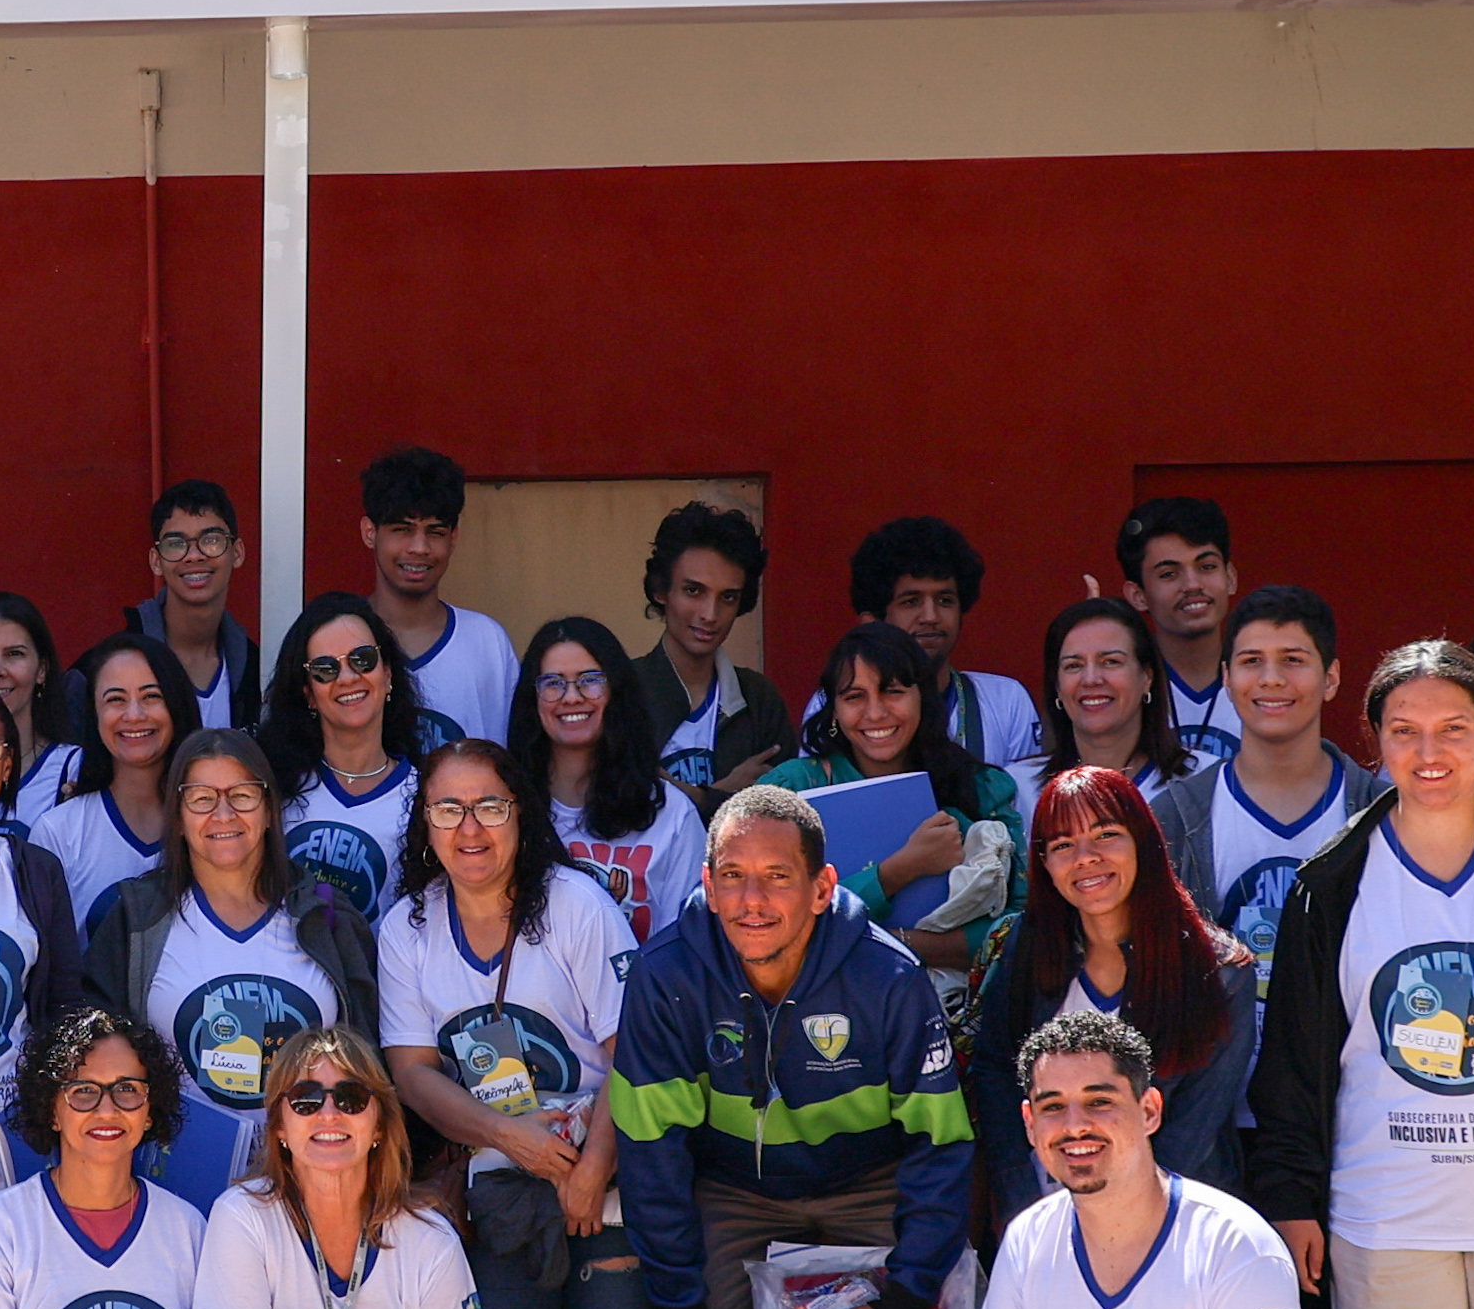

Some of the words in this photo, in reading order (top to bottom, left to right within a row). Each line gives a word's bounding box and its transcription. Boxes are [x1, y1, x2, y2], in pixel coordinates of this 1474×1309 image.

[305, 827, 367, 873] ENEM
[210, 1052, 247, 1071] Lúcia
[1388, 1111, 1465, 1126] SUBSECRETARIA
[1388, 1125, 1455, 1145] INCLUSIVA
[1460, 1127, 1468, 1143] E
